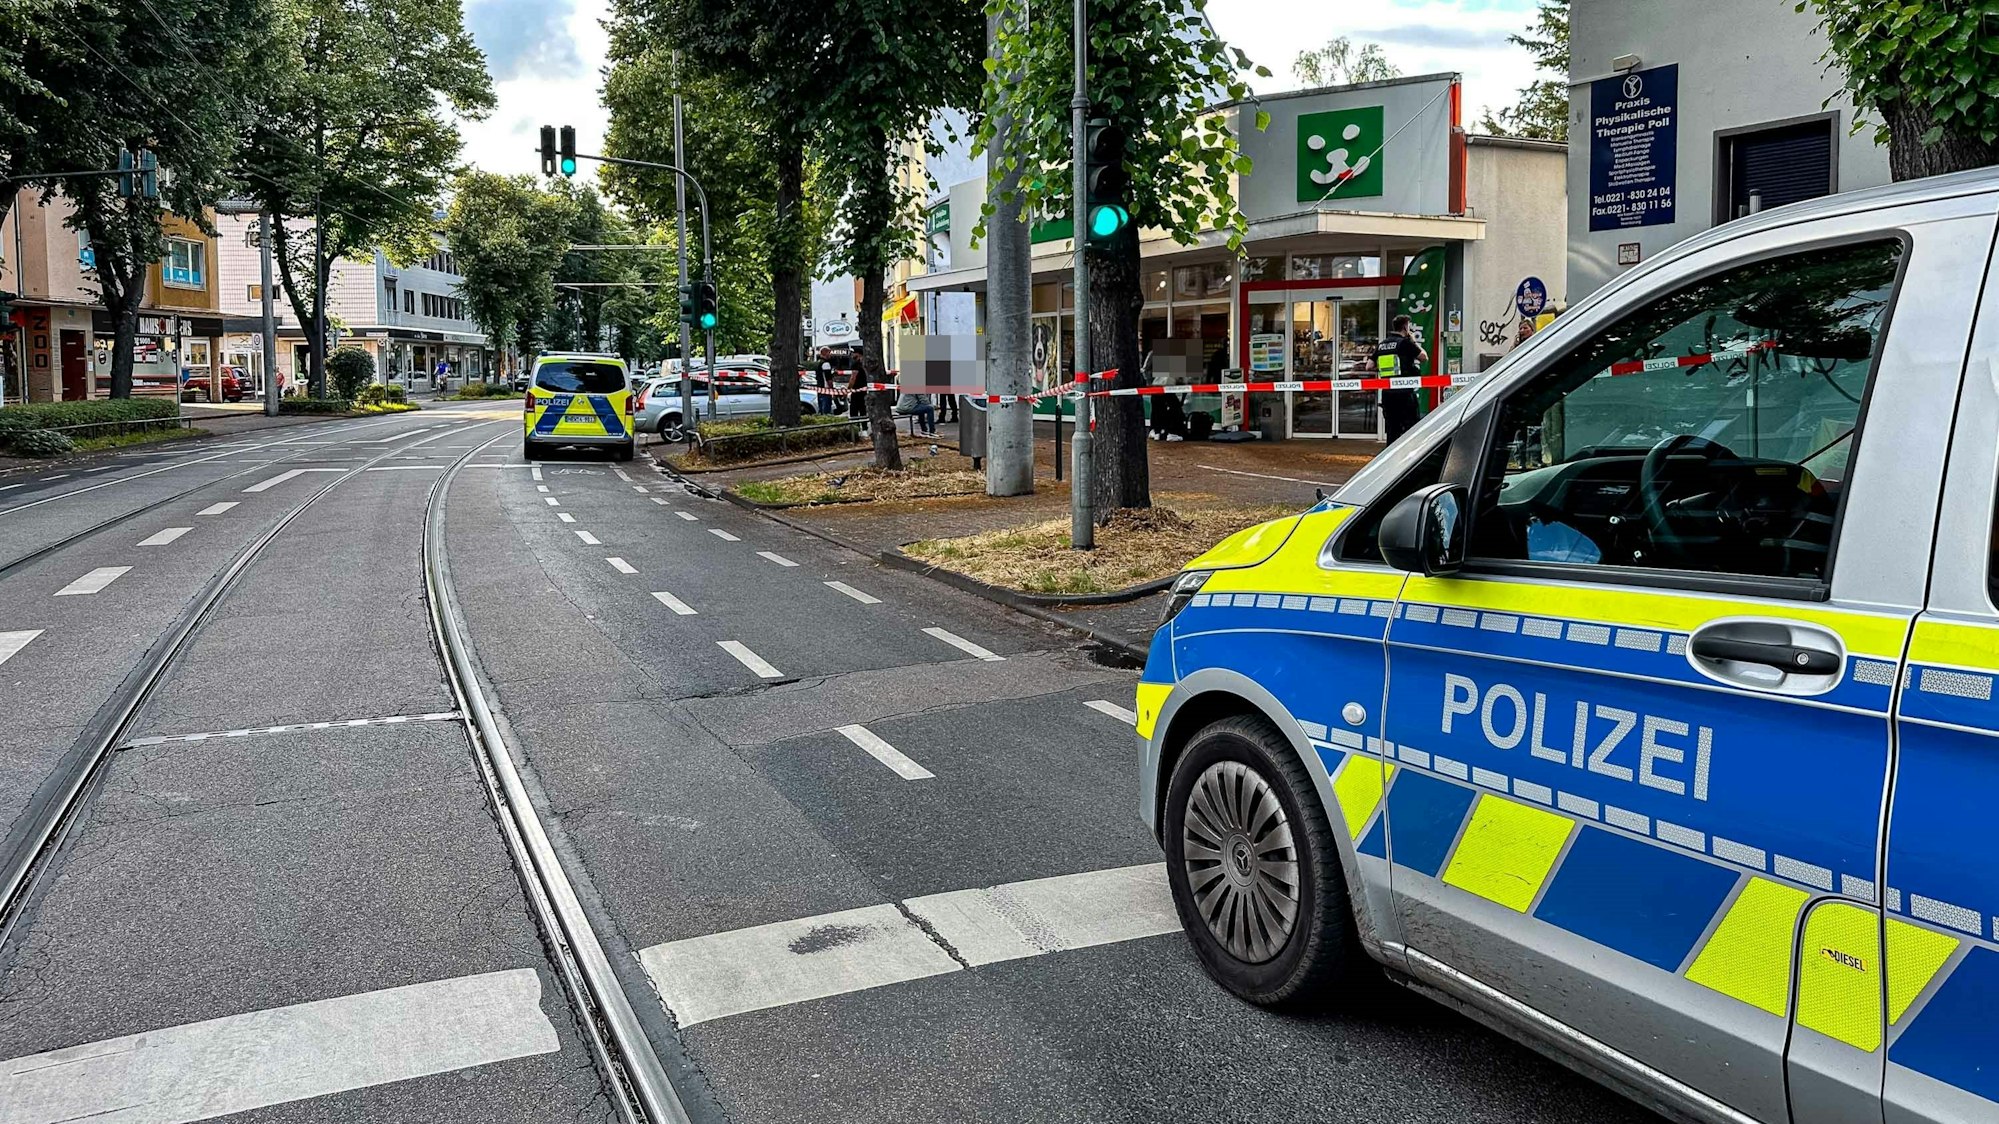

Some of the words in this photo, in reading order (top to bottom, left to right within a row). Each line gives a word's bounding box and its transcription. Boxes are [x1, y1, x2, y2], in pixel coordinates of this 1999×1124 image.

[1615, 97, 1650, 111] Praxis
[1595, 106, 1672, 126] Physikalische
[1596, 123, 1645, 138] Therapie
[1648, 117, 1669, 129] Poll
[1647, 188, 1658, 198] 24
[1659, 186, 1670, 196] 04
[1631, 201, 1647, 212] 830
[1649, 200, 1658, 210] 11
[1661, 198, 1672, 208] 56
[139, 317, 160, 334] HAUS
[33, 315, 48, 368] ZOO
[1378, 341, 1398, 351] POLIZEI
[536, 398, 570, 406] POLIZEI
[1441, 672, 1713, 802] POLIZEI
[1834, 950, 1865, 972] DIESEL
